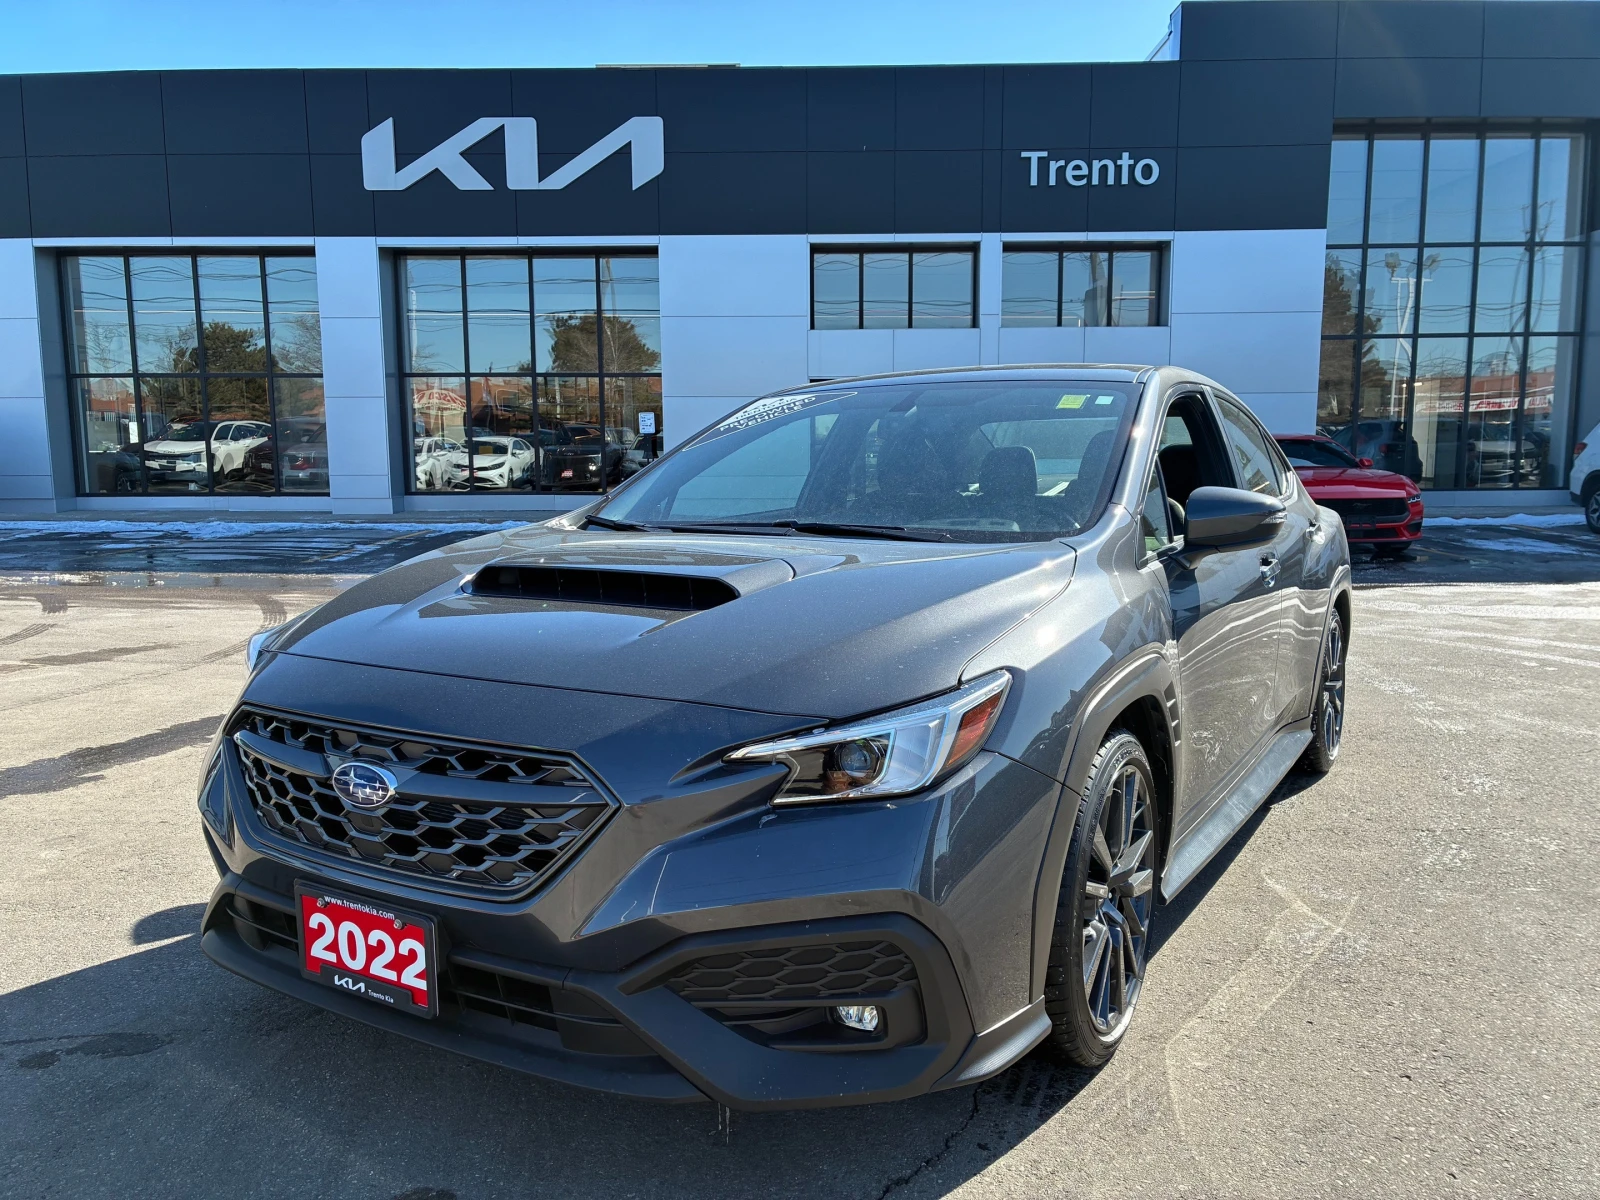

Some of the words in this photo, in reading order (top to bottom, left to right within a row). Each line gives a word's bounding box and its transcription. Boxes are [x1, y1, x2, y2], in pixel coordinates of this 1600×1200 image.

[361, 116, 665, 191] KIA
[1020, 150, 1160, 187] Trento
[719, 396, 816, 431] PRE-OWNED
[737, 404, 803, 429] VEHICLE
[323, 895, 395, 920] www.trentokia.com
[308, 912, 427, 991] 2022
[334, 975, 366, 993] KIA
[368, 990, 384, 1001] Trento
[385, 994, 394, 1003] Kia
